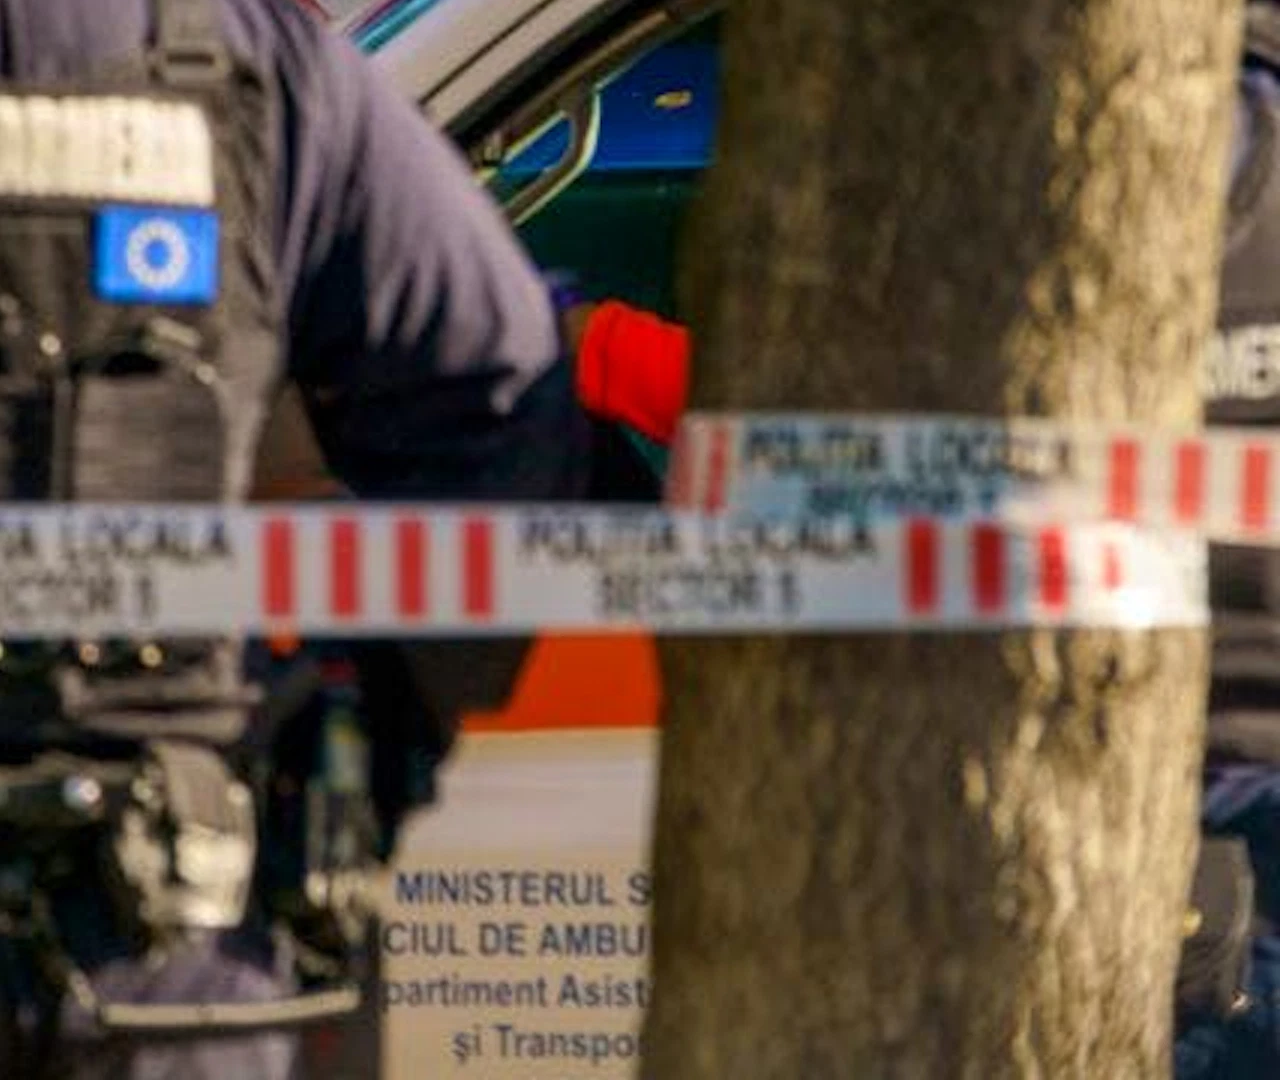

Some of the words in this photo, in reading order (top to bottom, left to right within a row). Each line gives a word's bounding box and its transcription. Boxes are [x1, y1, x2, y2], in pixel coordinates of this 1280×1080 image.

[396, 871, 615, 907] MINISTERUL
[383, 922, 467, 957] CIUL
[479, 922, 527, 957] DE
[540, 922, 647, 957] AMBU
